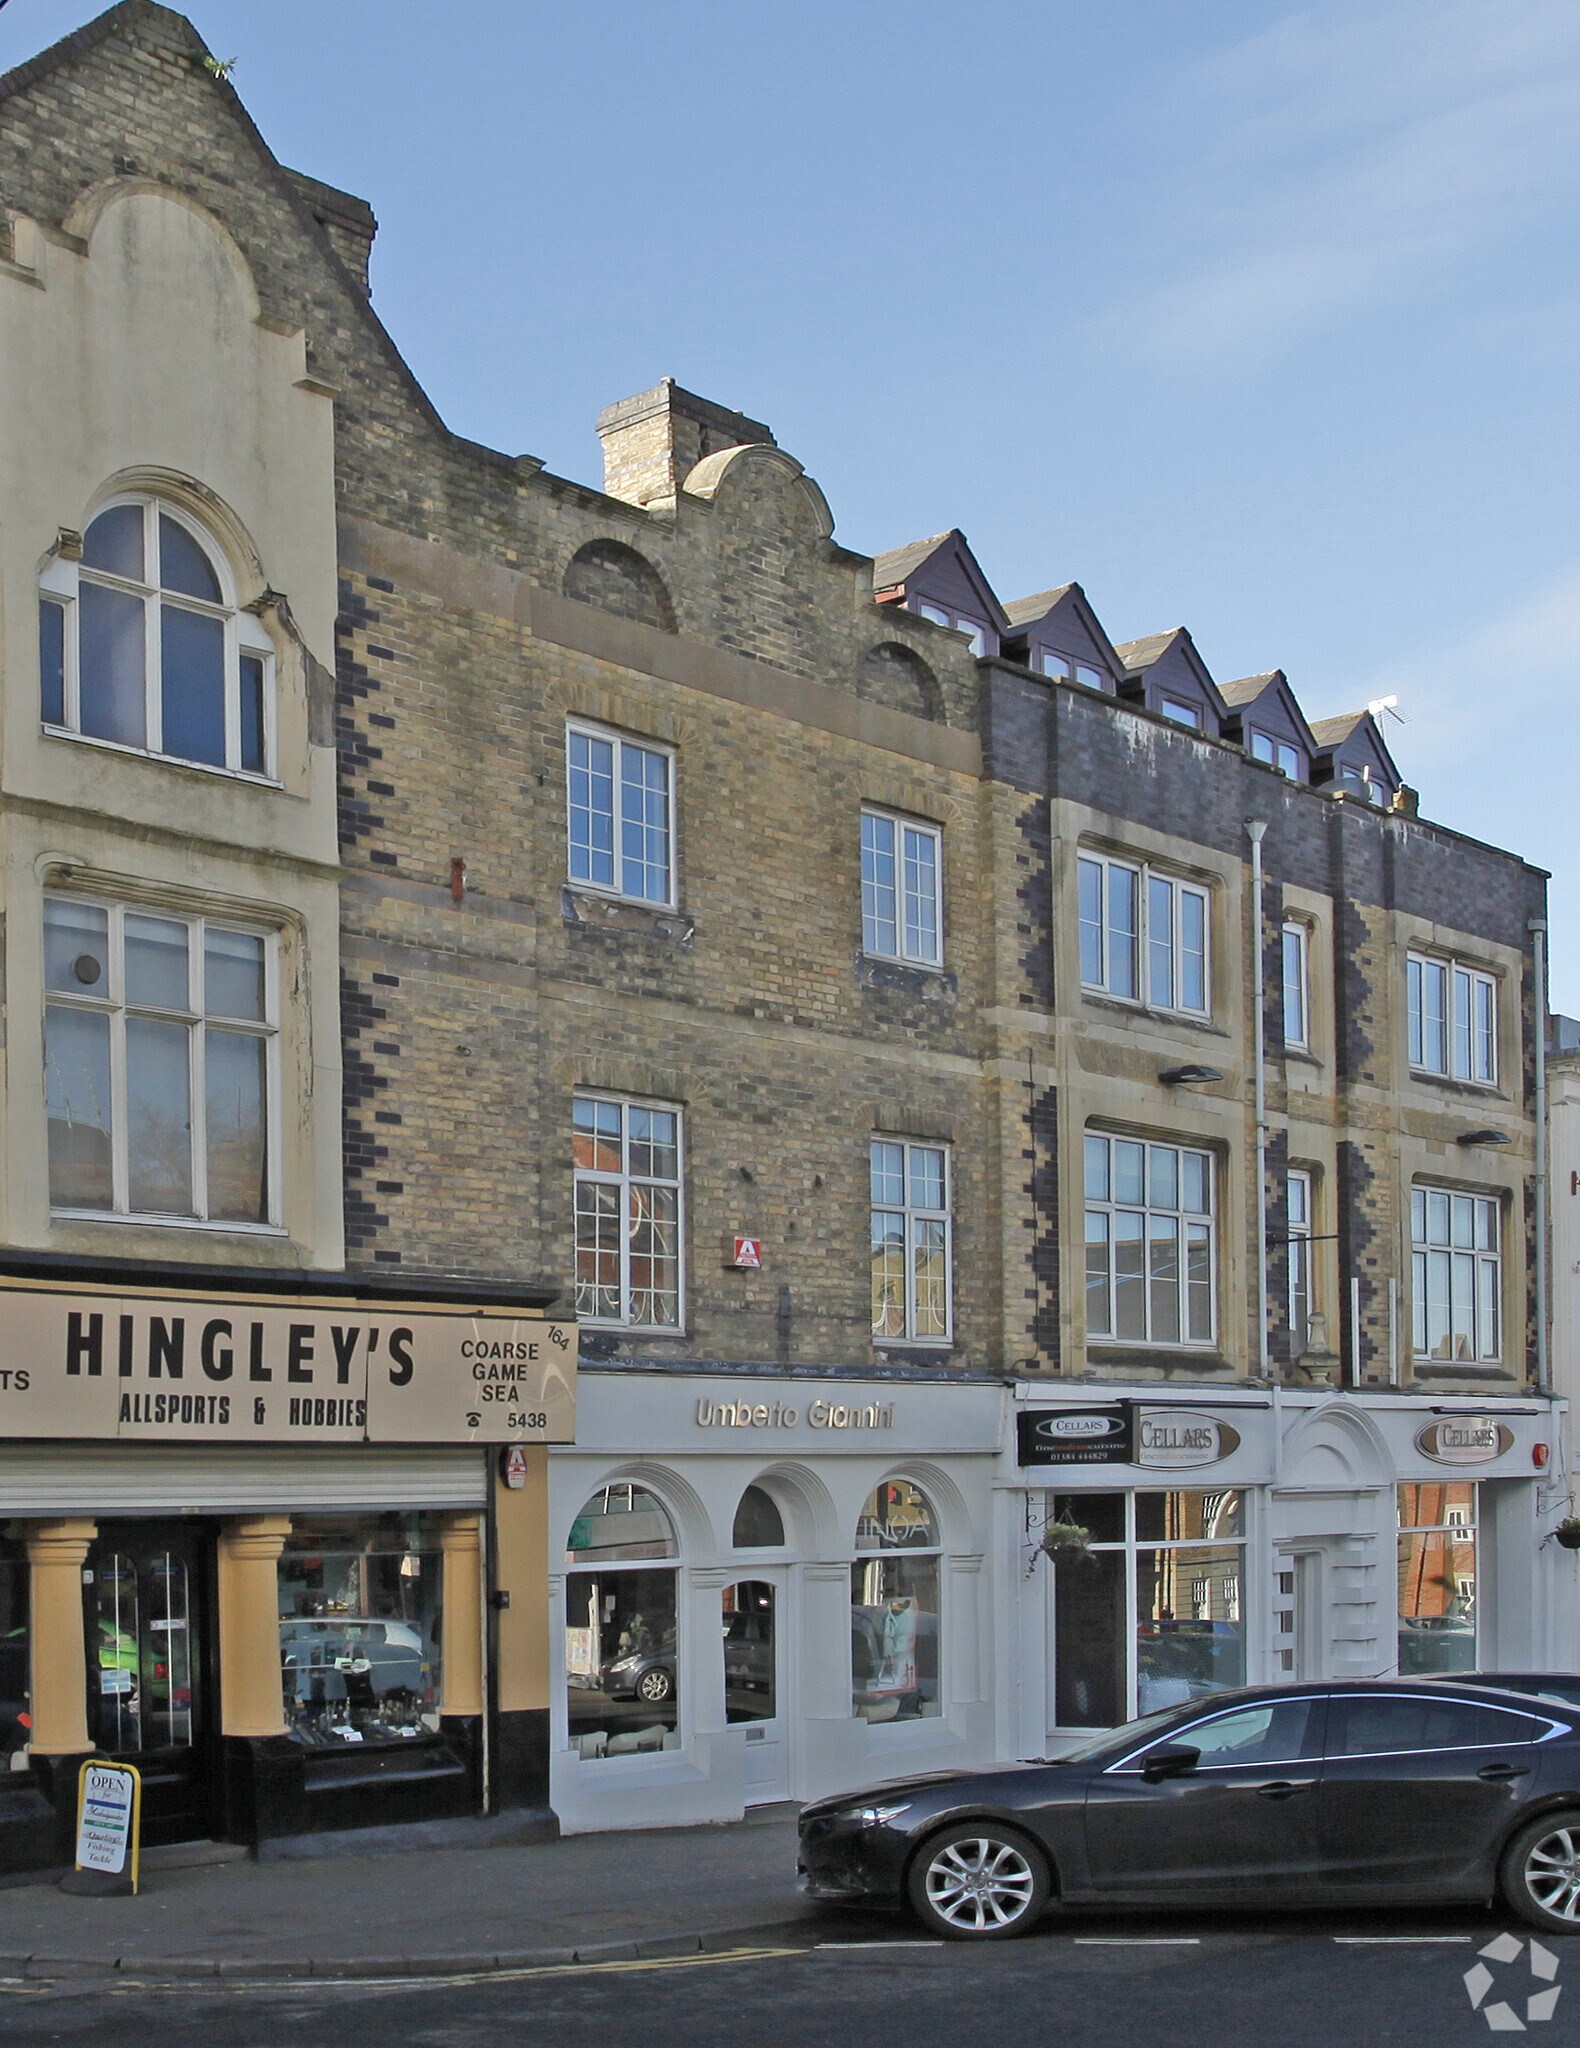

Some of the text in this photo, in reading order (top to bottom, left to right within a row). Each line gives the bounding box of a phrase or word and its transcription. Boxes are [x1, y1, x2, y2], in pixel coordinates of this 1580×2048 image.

[66, 1311, 414, 1387] HINGLEY'S
[547, 1325, 570, 1351] 164
[461, 1340, 539, 1360] COARSE
[472, 1362, 528, 1381] GAME
[481, 1384, 520, 1402] SEA
[119, 1393, 366, 1427] ALLSPORTS & HOBBIES
[507, 1412, 547, 1428] 5438
[697, 1398, 896, 1429] Umberto Giannini
[1056, 1420, 1104, 1432] CELLARS
[1140, 1420, 1213, 1449] CELLARS
[1442, 1423, 1496, 1448] CELLARS
[91, 1775, 124, 1791] OPEN
